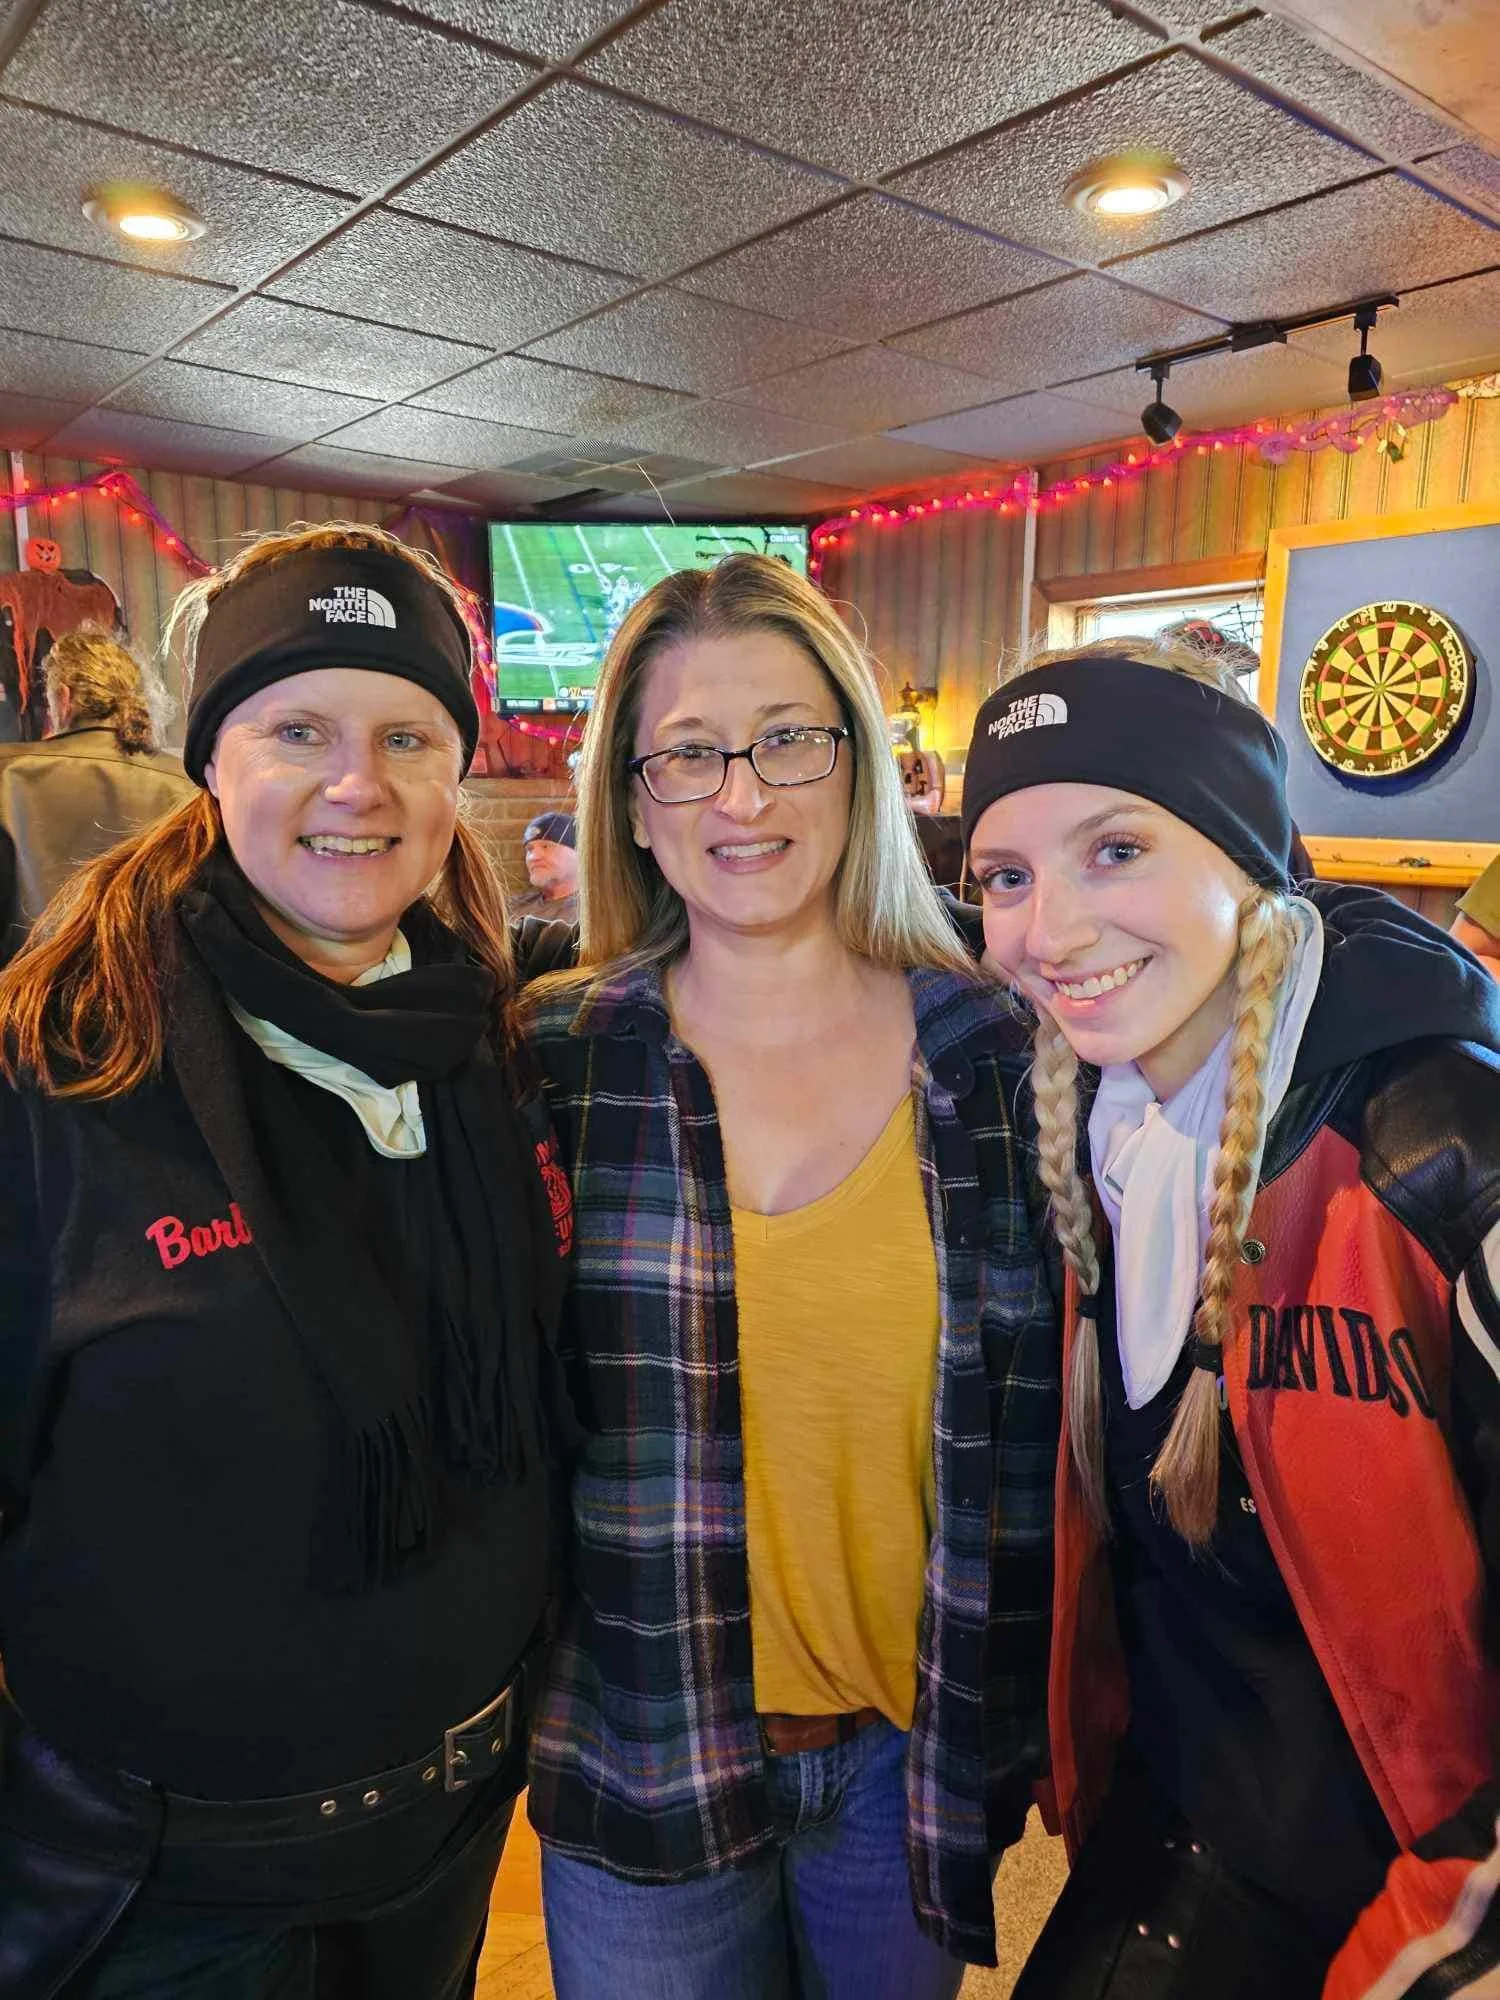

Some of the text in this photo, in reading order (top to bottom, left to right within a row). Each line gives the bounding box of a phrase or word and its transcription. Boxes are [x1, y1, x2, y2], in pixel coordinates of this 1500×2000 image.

[333, 586, 367, 601] THE
[308, 597, 367, 612] NORTH
[325, 609, 368, 624] FACE
[1008, 694, 1040, 714] THE
[988, 705, 1037, 737] NORTH
[998, 716, 1035, 741] FACE
